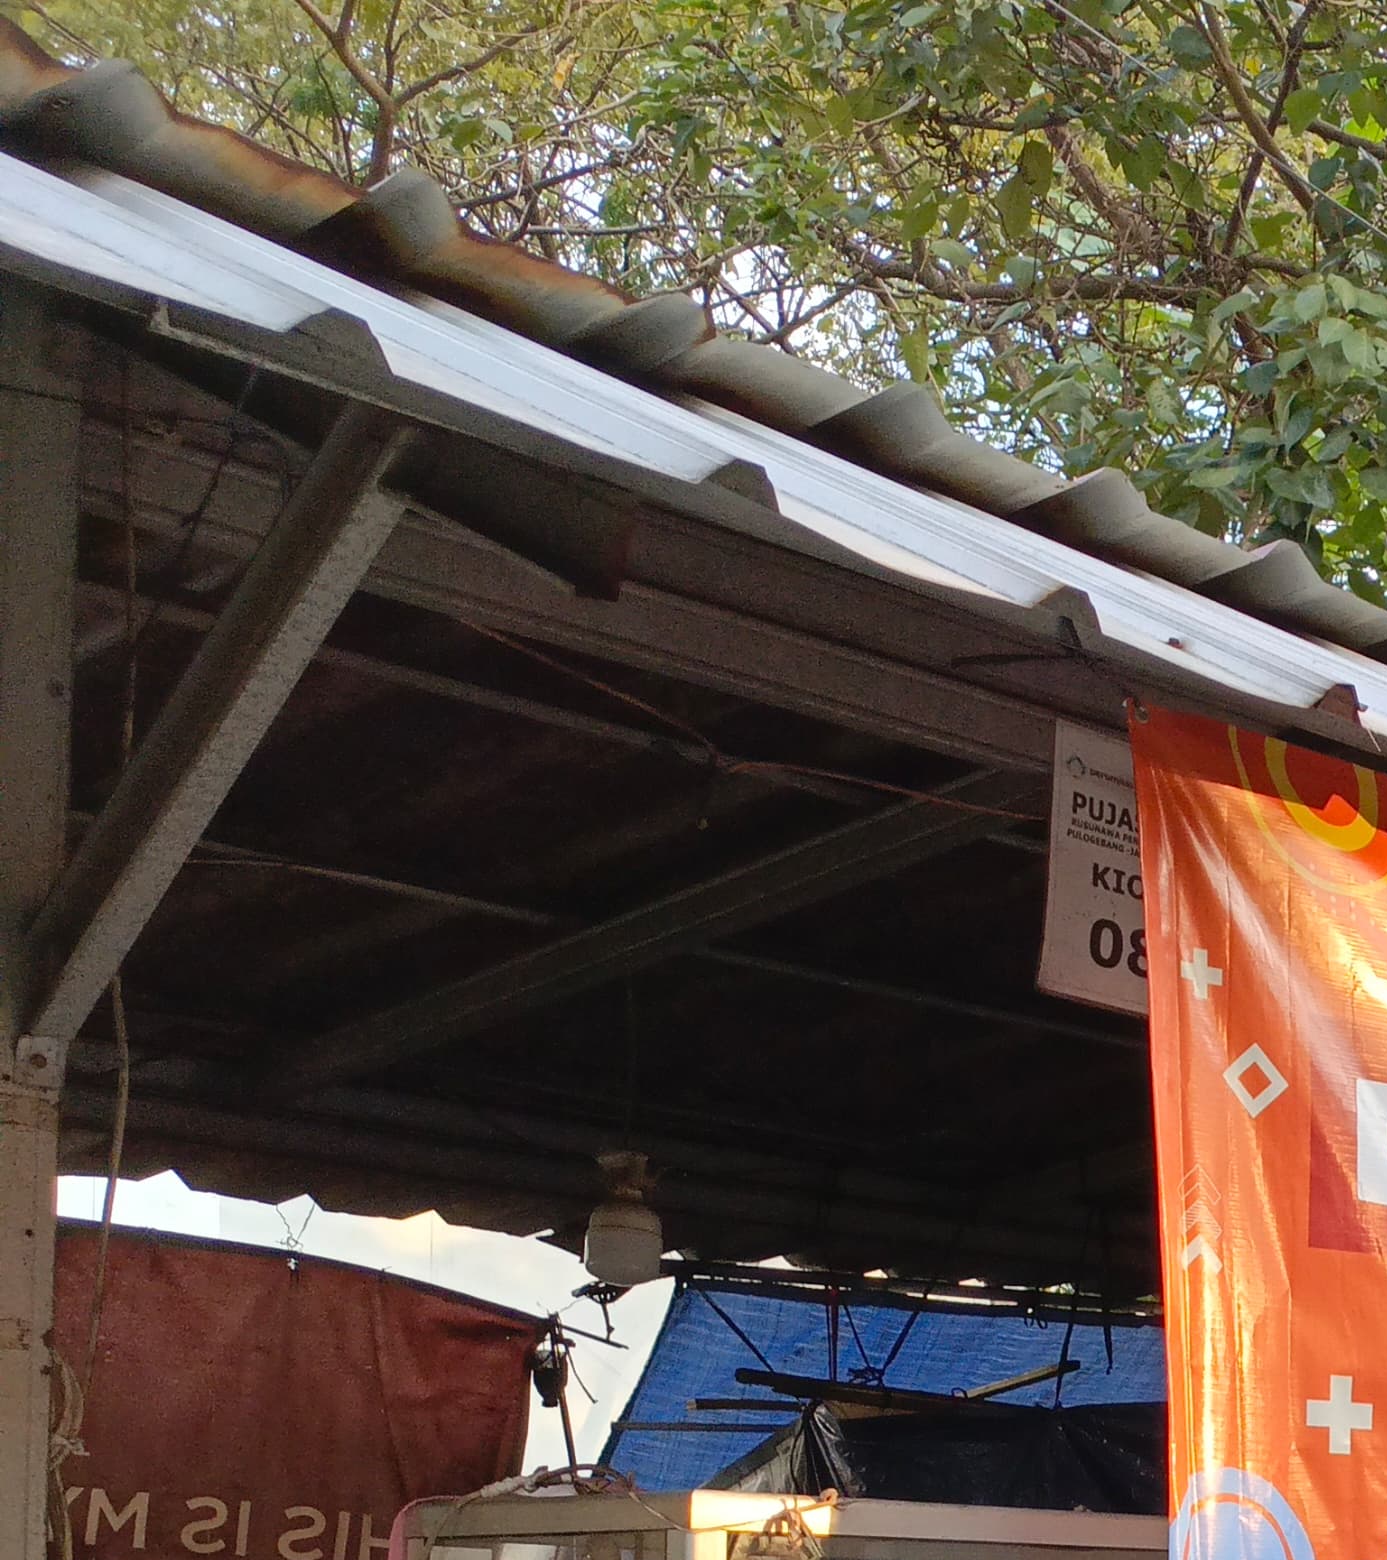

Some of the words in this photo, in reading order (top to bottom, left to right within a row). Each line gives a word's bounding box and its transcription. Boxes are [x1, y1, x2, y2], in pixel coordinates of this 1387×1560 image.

[1072, 791, 1139, 832] PUJA
[1067, 828, 1124, 853] PULOGEBANG
[1089, 918, 1148, 978] 08
